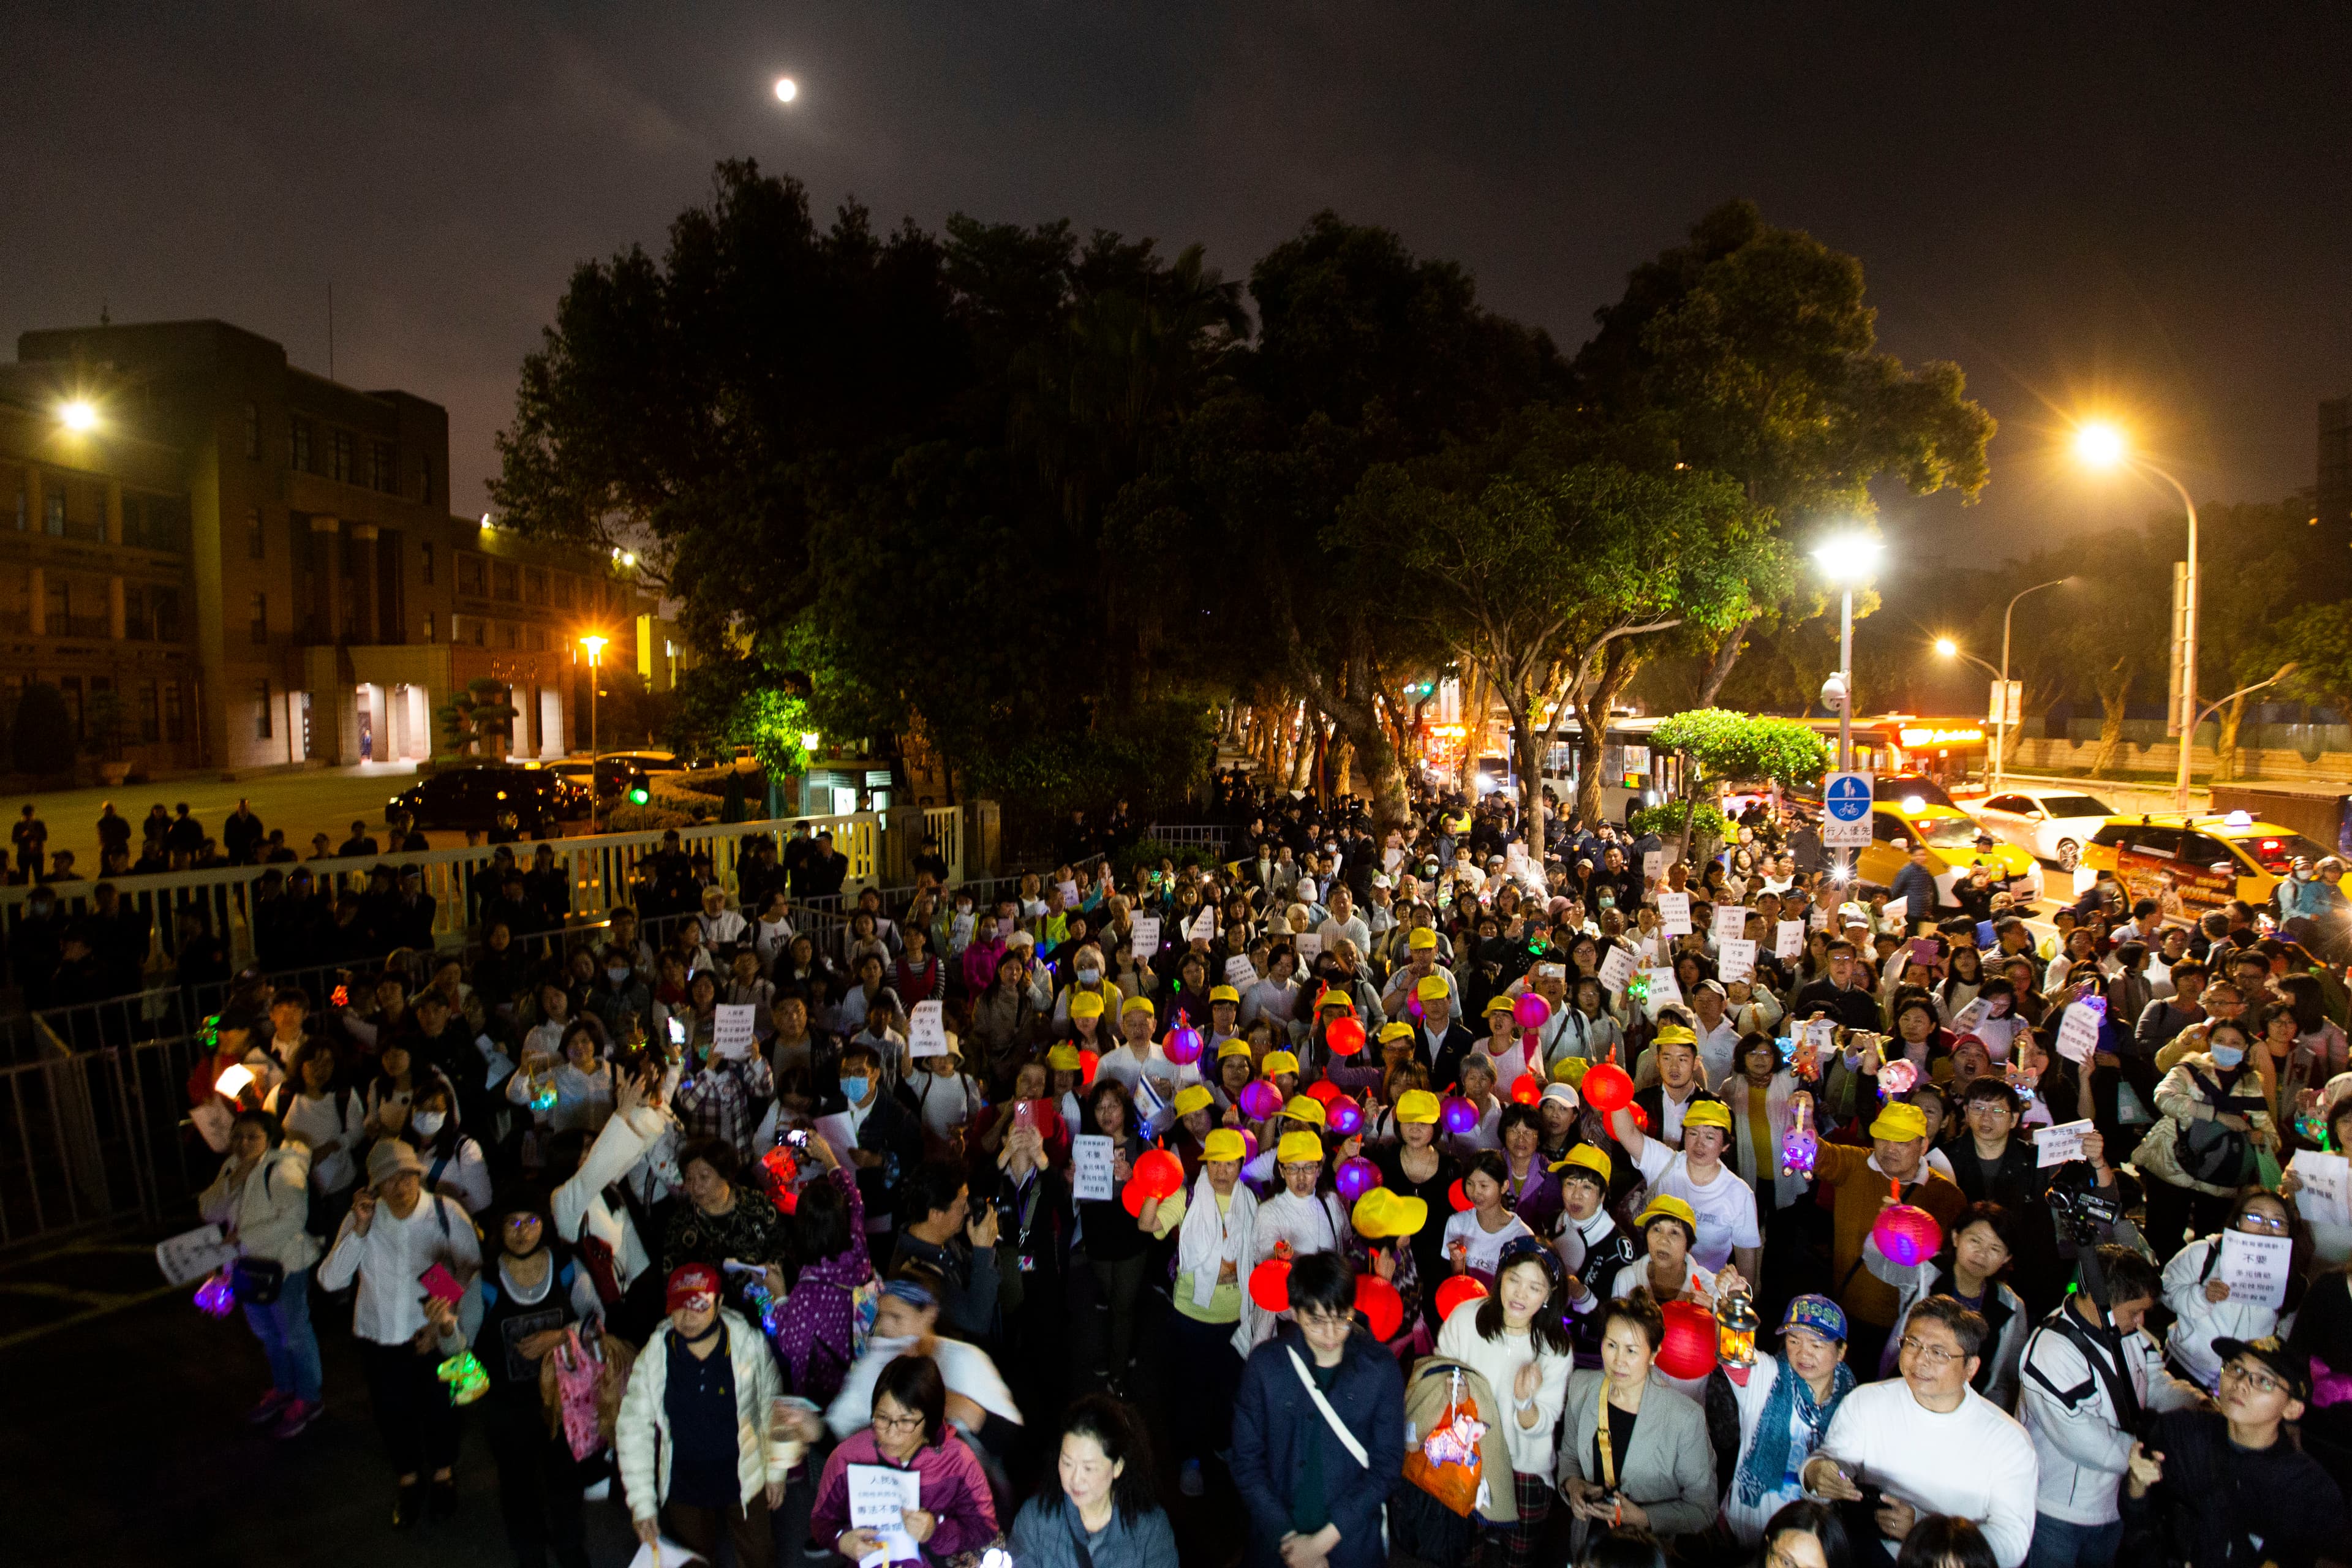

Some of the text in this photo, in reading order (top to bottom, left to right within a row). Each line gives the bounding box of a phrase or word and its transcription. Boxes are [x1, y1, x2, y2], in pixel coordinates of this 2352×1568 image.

[1826, 826, 1871, 836] 行人優先
[1651, 975, 1669, 984] 男一女
[1085, 1151, 1101, 1159] 不要
[1622, 1238, 1634, 1261] B
[2243, 1253, 2267, 1264] 不要
[858, 1505, 899, 1515] 專法不要
